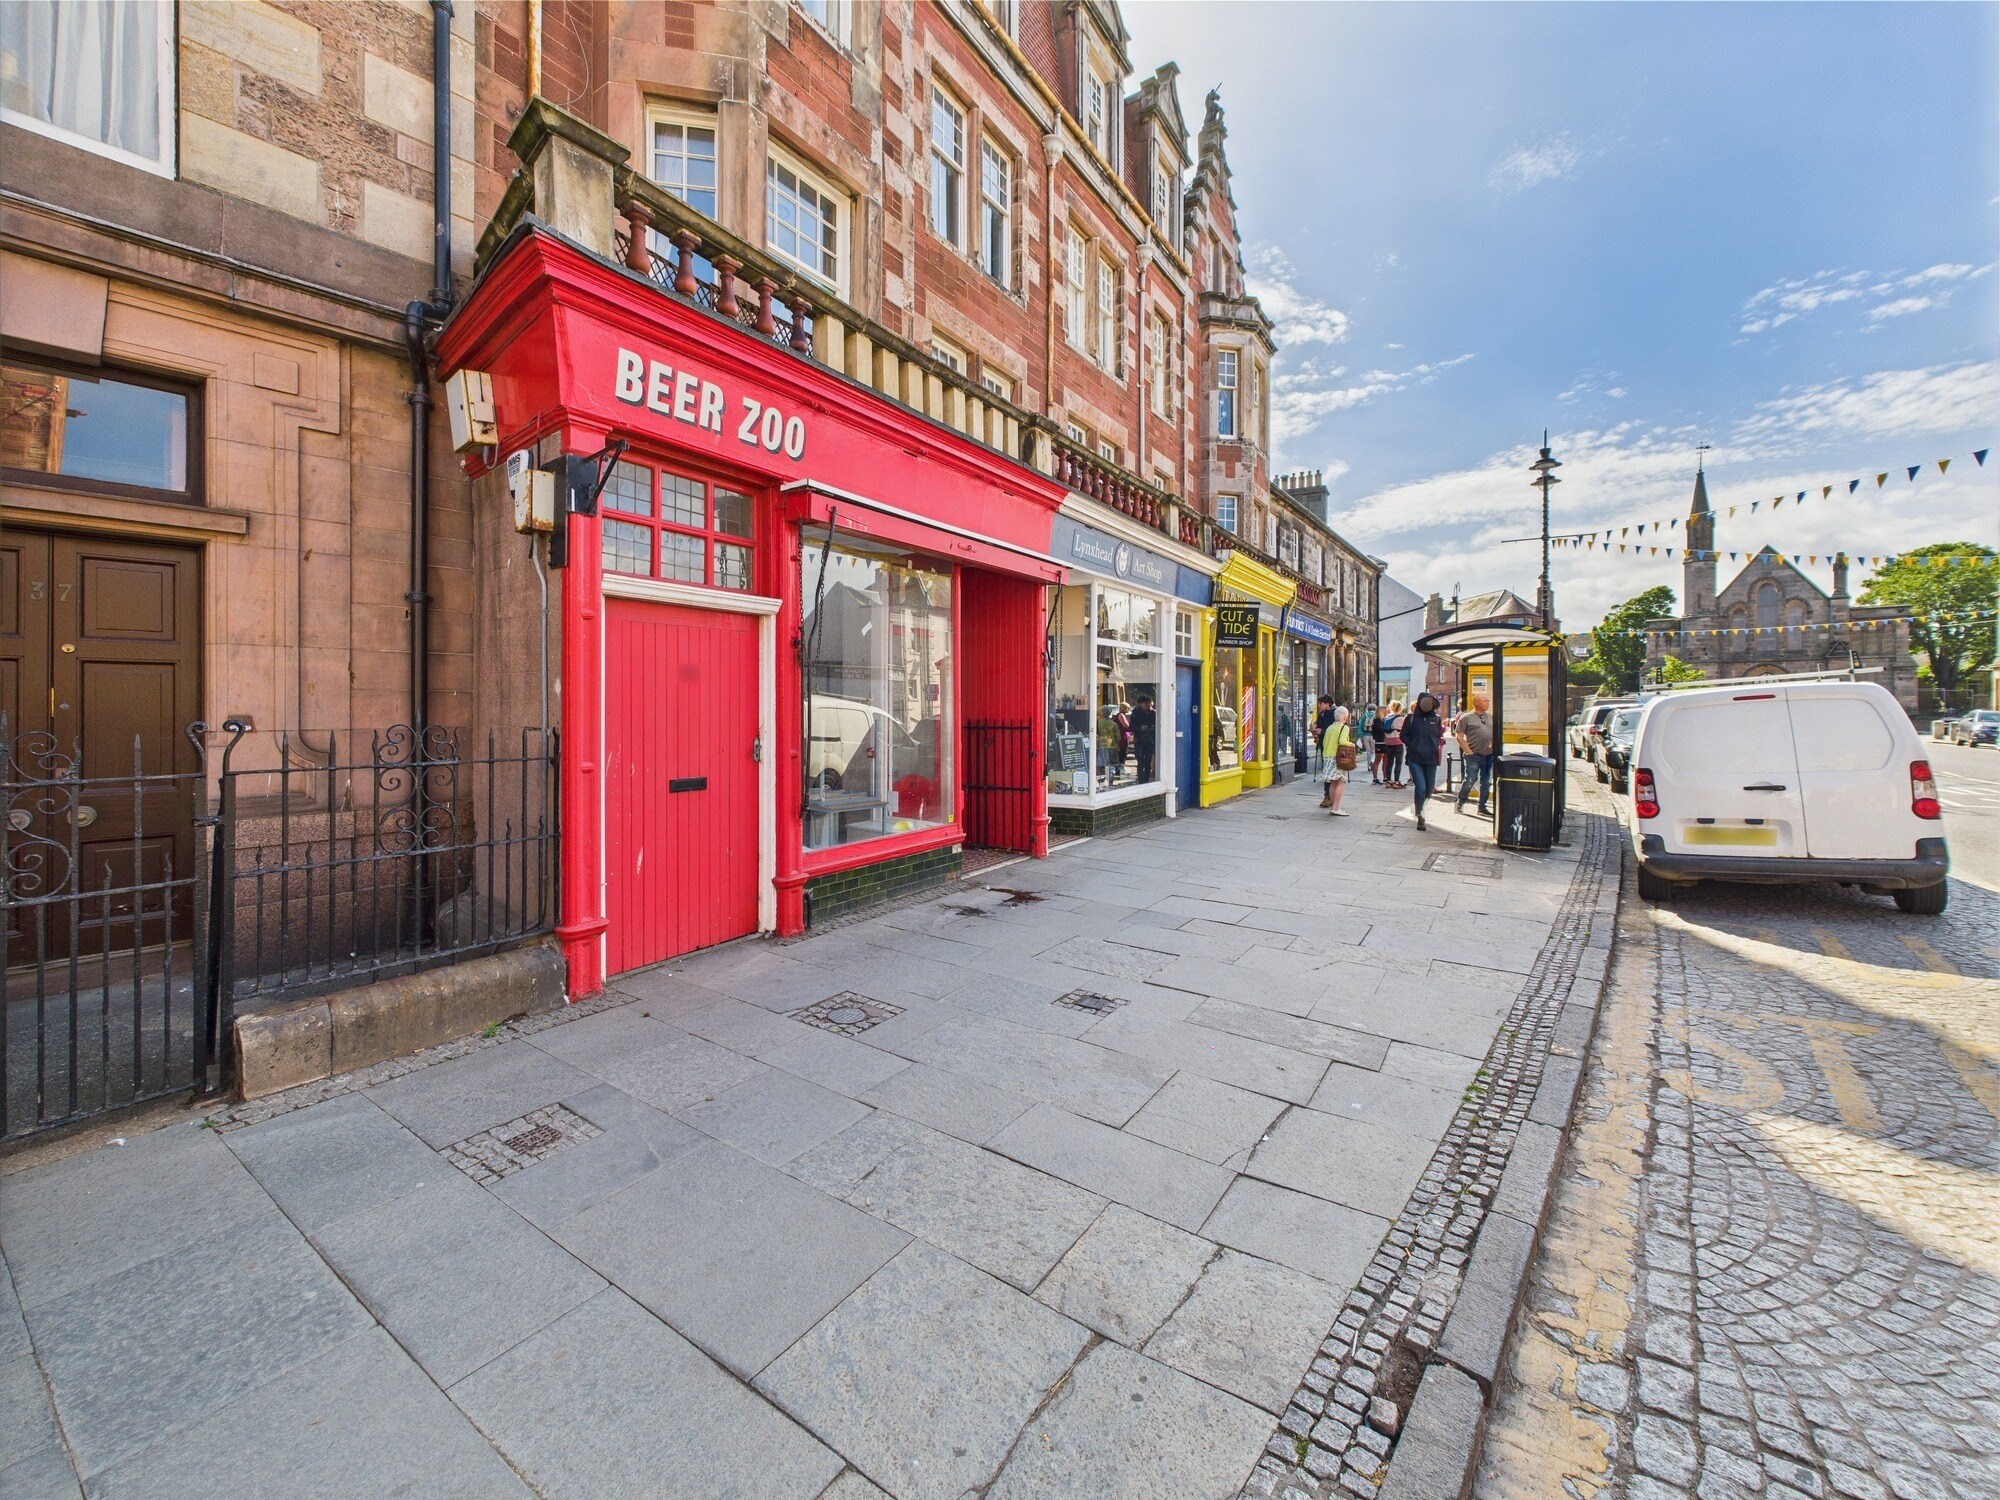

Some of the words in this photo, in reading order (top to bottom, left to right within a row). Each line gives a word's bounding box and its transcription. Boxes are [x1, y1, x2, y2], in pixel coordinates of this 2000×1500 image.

[615, 347, 725, 434] BEER
[738, 396, 805, 461] ZOO
[1075, 534, 1114, 563] Lynxhead
[1133, 557, 1145, 574] Art
[1146, 561, 1162, 584] Shop
[1220, 610, 1244, 622] CUT
[1247, 614, 1255, 623] &
[1223, 622, 1251, 635] TIDE
